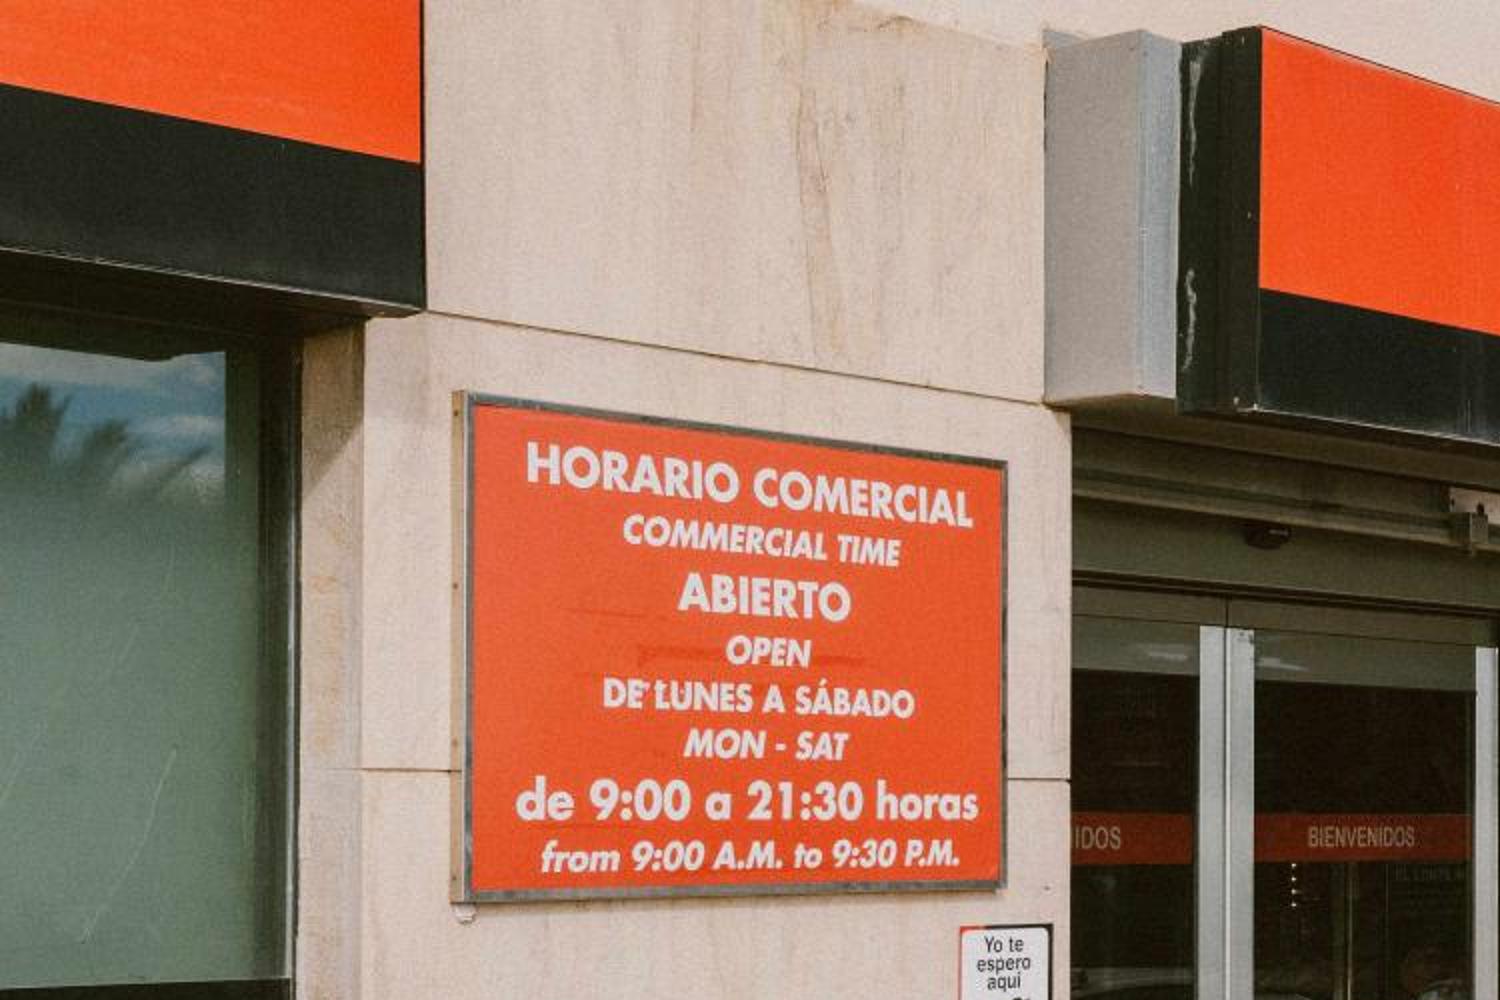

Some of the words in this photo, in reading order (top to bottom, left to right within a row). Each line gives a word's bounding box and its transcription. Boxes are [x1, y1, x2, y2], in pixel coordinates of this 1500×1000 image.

[527, 441, 740, 503] HORARIO
[753, 467, 973, 528] COMERCIAL
[623, 513, 827, 561] COMMERCIAL
[837, 534, 901, 567] TIME
[677, 572, 851, 622] ABIERTO
[726, 634, 812, 667] OPEN
[603, 677, 646, 709] DE
[654, 679, 753, 713] LUNES
[762, 684, 785, 713] A
[795, 678, 915, 719] SÁBADO
[683, 728, 767, 760] MON
[795, 731, 849, 761] SAT
[515, 775, 575, 821] de
[589, 778, 692, 822] 9:00
[704, 791, 732, 821] a
[747, 779, 864, 821] 21:30
[876, 778, 979, 821] horas
[1307, 825, 1416, 849] BIENVENIDOS
[541, 839, 621, 873] from
[631, 840, 706, 872] 9:00
[712, 840, 783, 870] A.M.
[794, 843, 823, 869] to
[832, 838, 898, 869] 9:30
[904, 839, 960, 867] P.M.
[984, 935, 1003, 952] Yo
[1008, 937, 1024, 952] te
[977, 957, 1031, 975] espero
